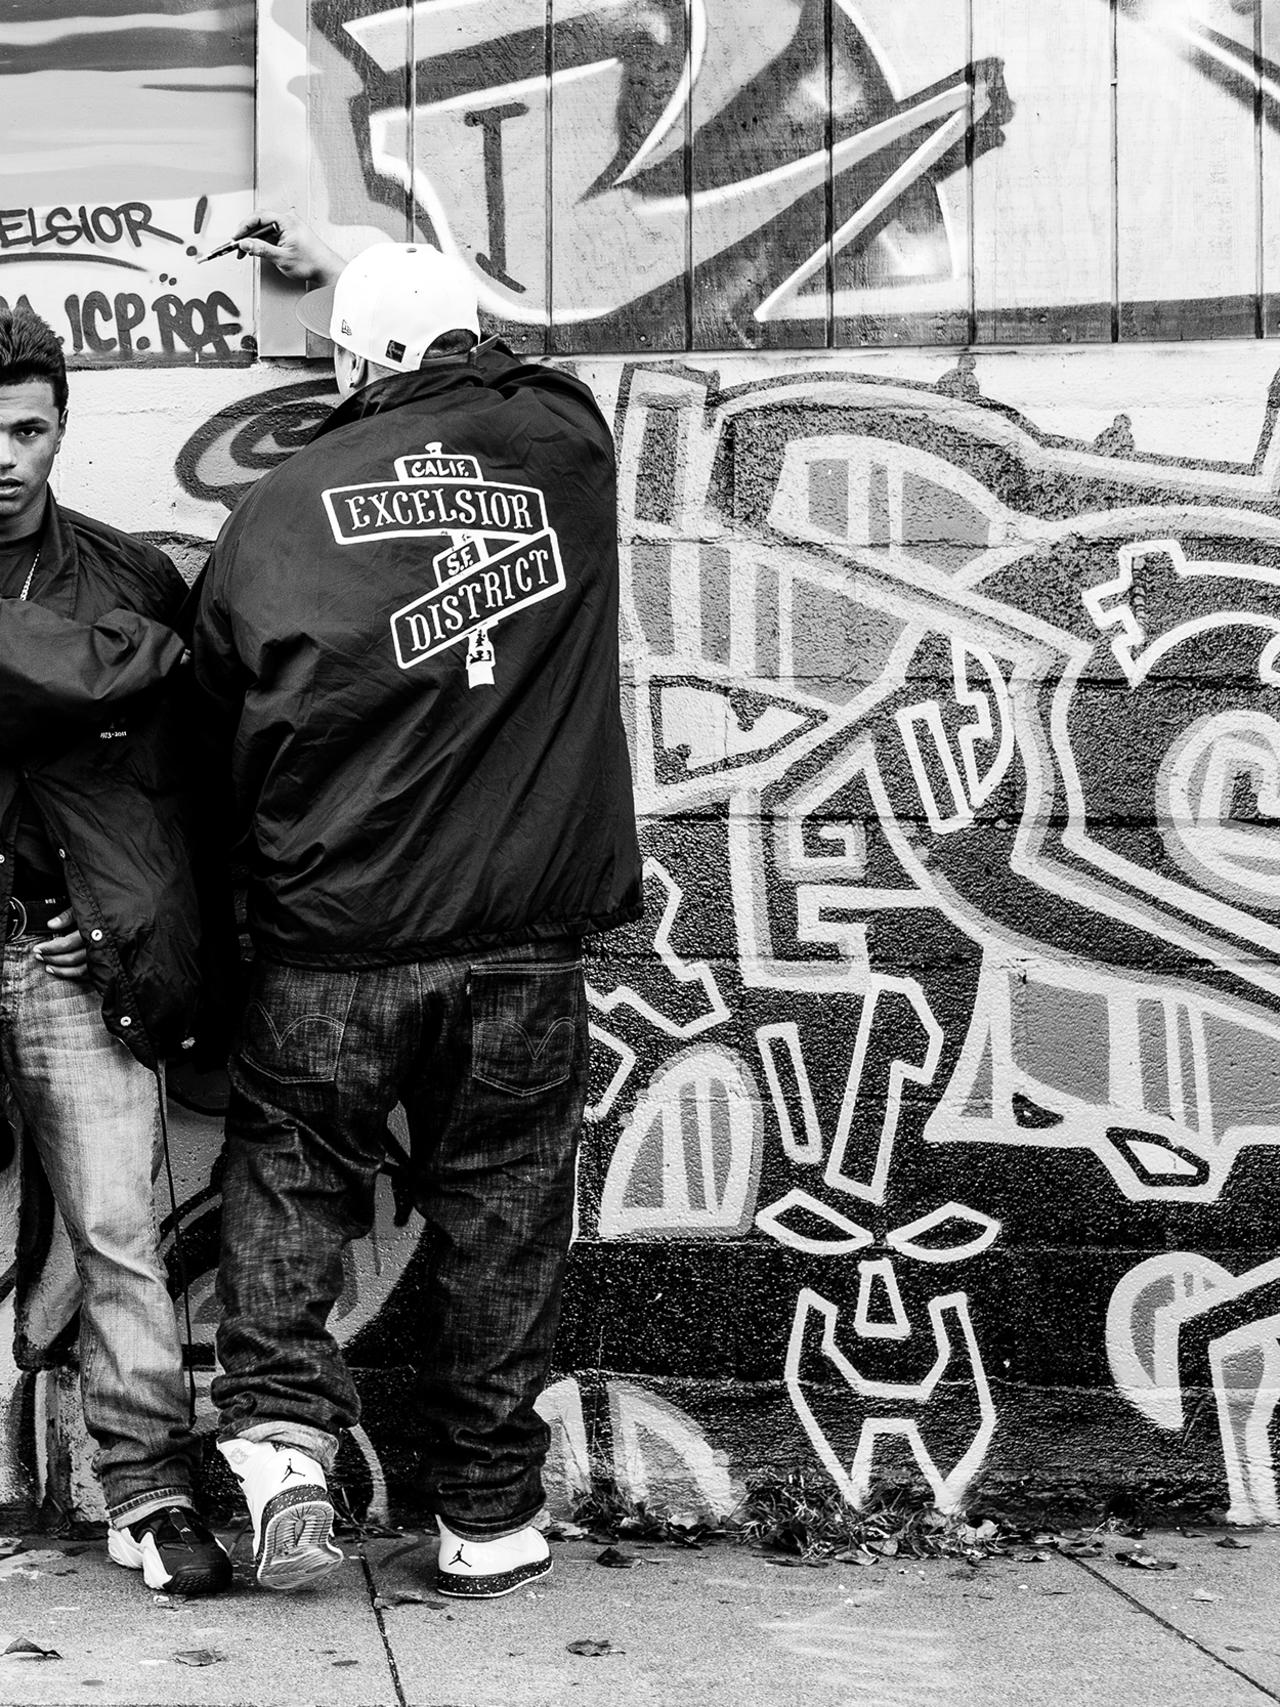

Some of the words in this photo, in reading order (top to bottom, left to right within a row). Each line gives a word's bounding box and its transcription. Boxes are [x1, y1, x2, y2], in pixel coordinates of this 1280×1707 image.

[411, 459, 470, 478] CALIF.
[344, 487, 534, 531] EXCELSIOR
[446, 548, 474, 576] S.F.
[405, 549, 550, 652] DISTRICT
